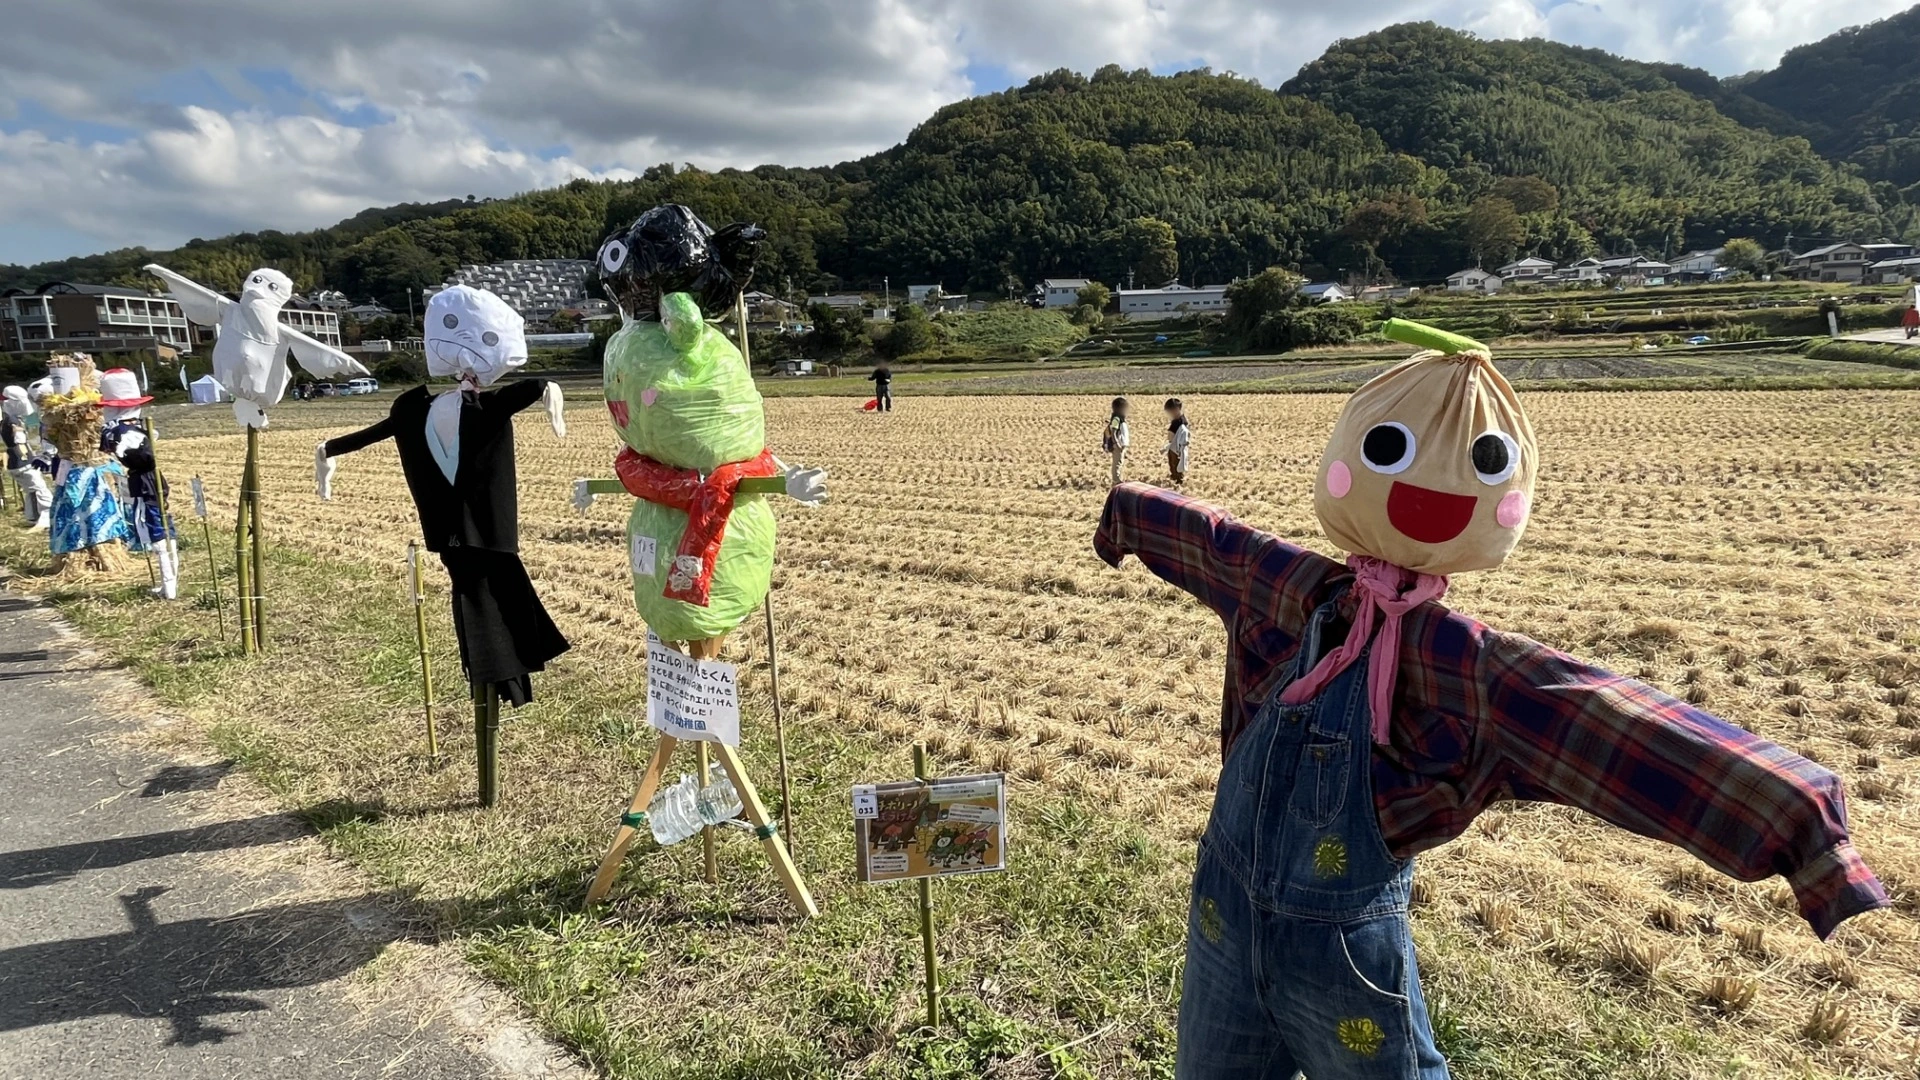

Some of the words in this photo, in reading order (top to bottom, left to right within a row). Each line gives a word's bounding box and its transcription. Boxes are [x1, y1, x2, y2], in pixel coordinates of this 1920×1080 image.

[858, 806, 874, 814] 033
[878, 798, 918, 812] チポリーノ
